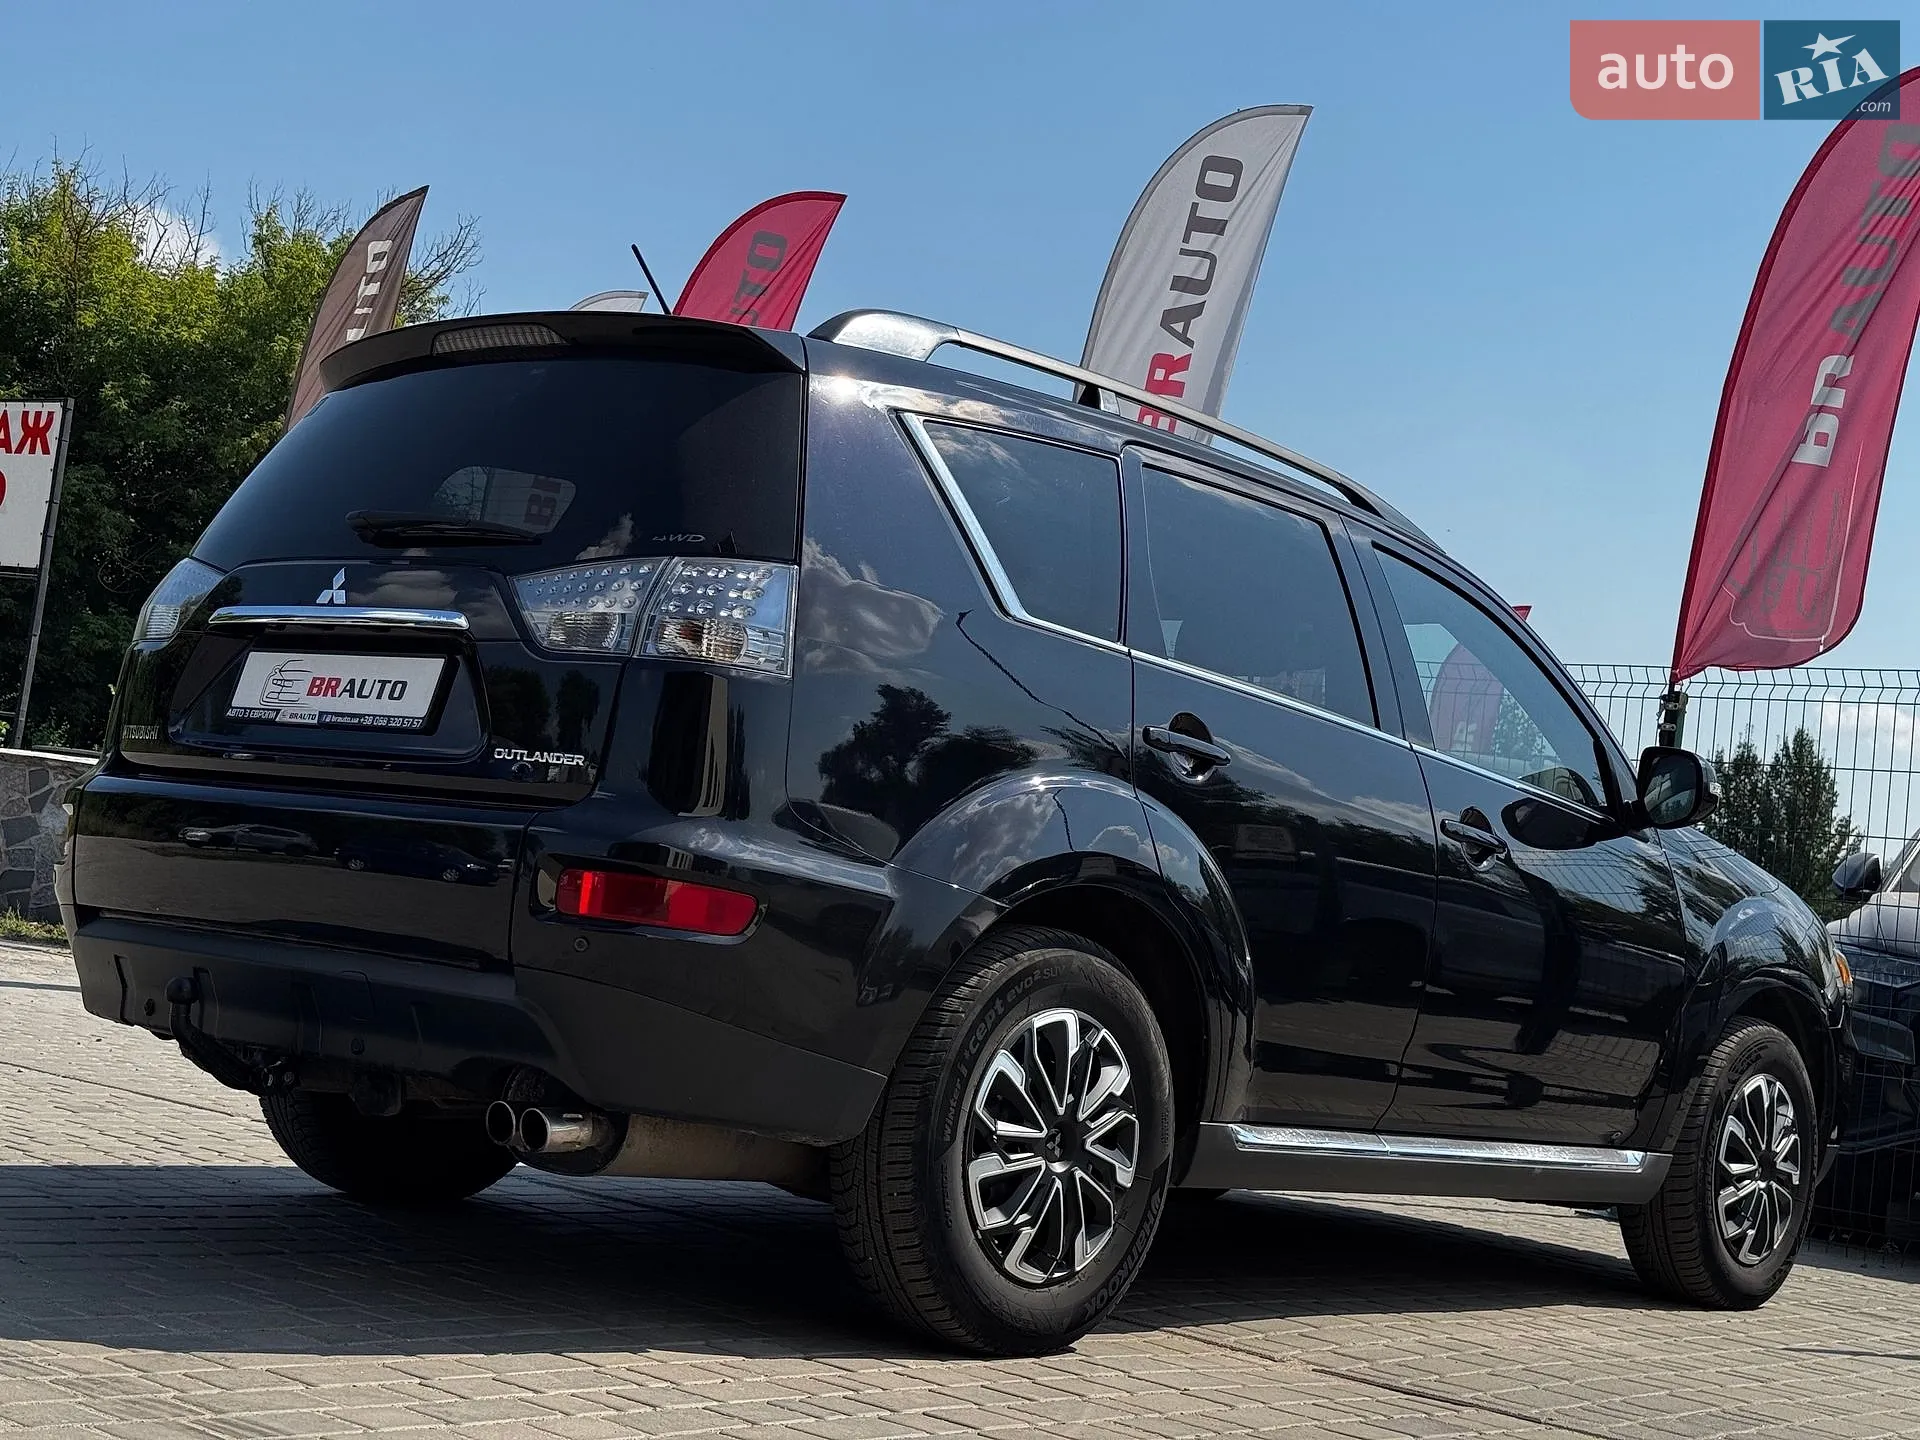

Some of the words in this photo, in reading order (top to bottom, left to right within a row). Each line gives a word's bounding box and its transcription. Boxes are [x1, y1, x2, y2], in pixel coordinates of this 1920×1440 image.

[306, 676, 408, 701] BRAUTO
[288, 712, 317, 721] BRAUTO
[493, 748, 585, 766] OUTLANDER
